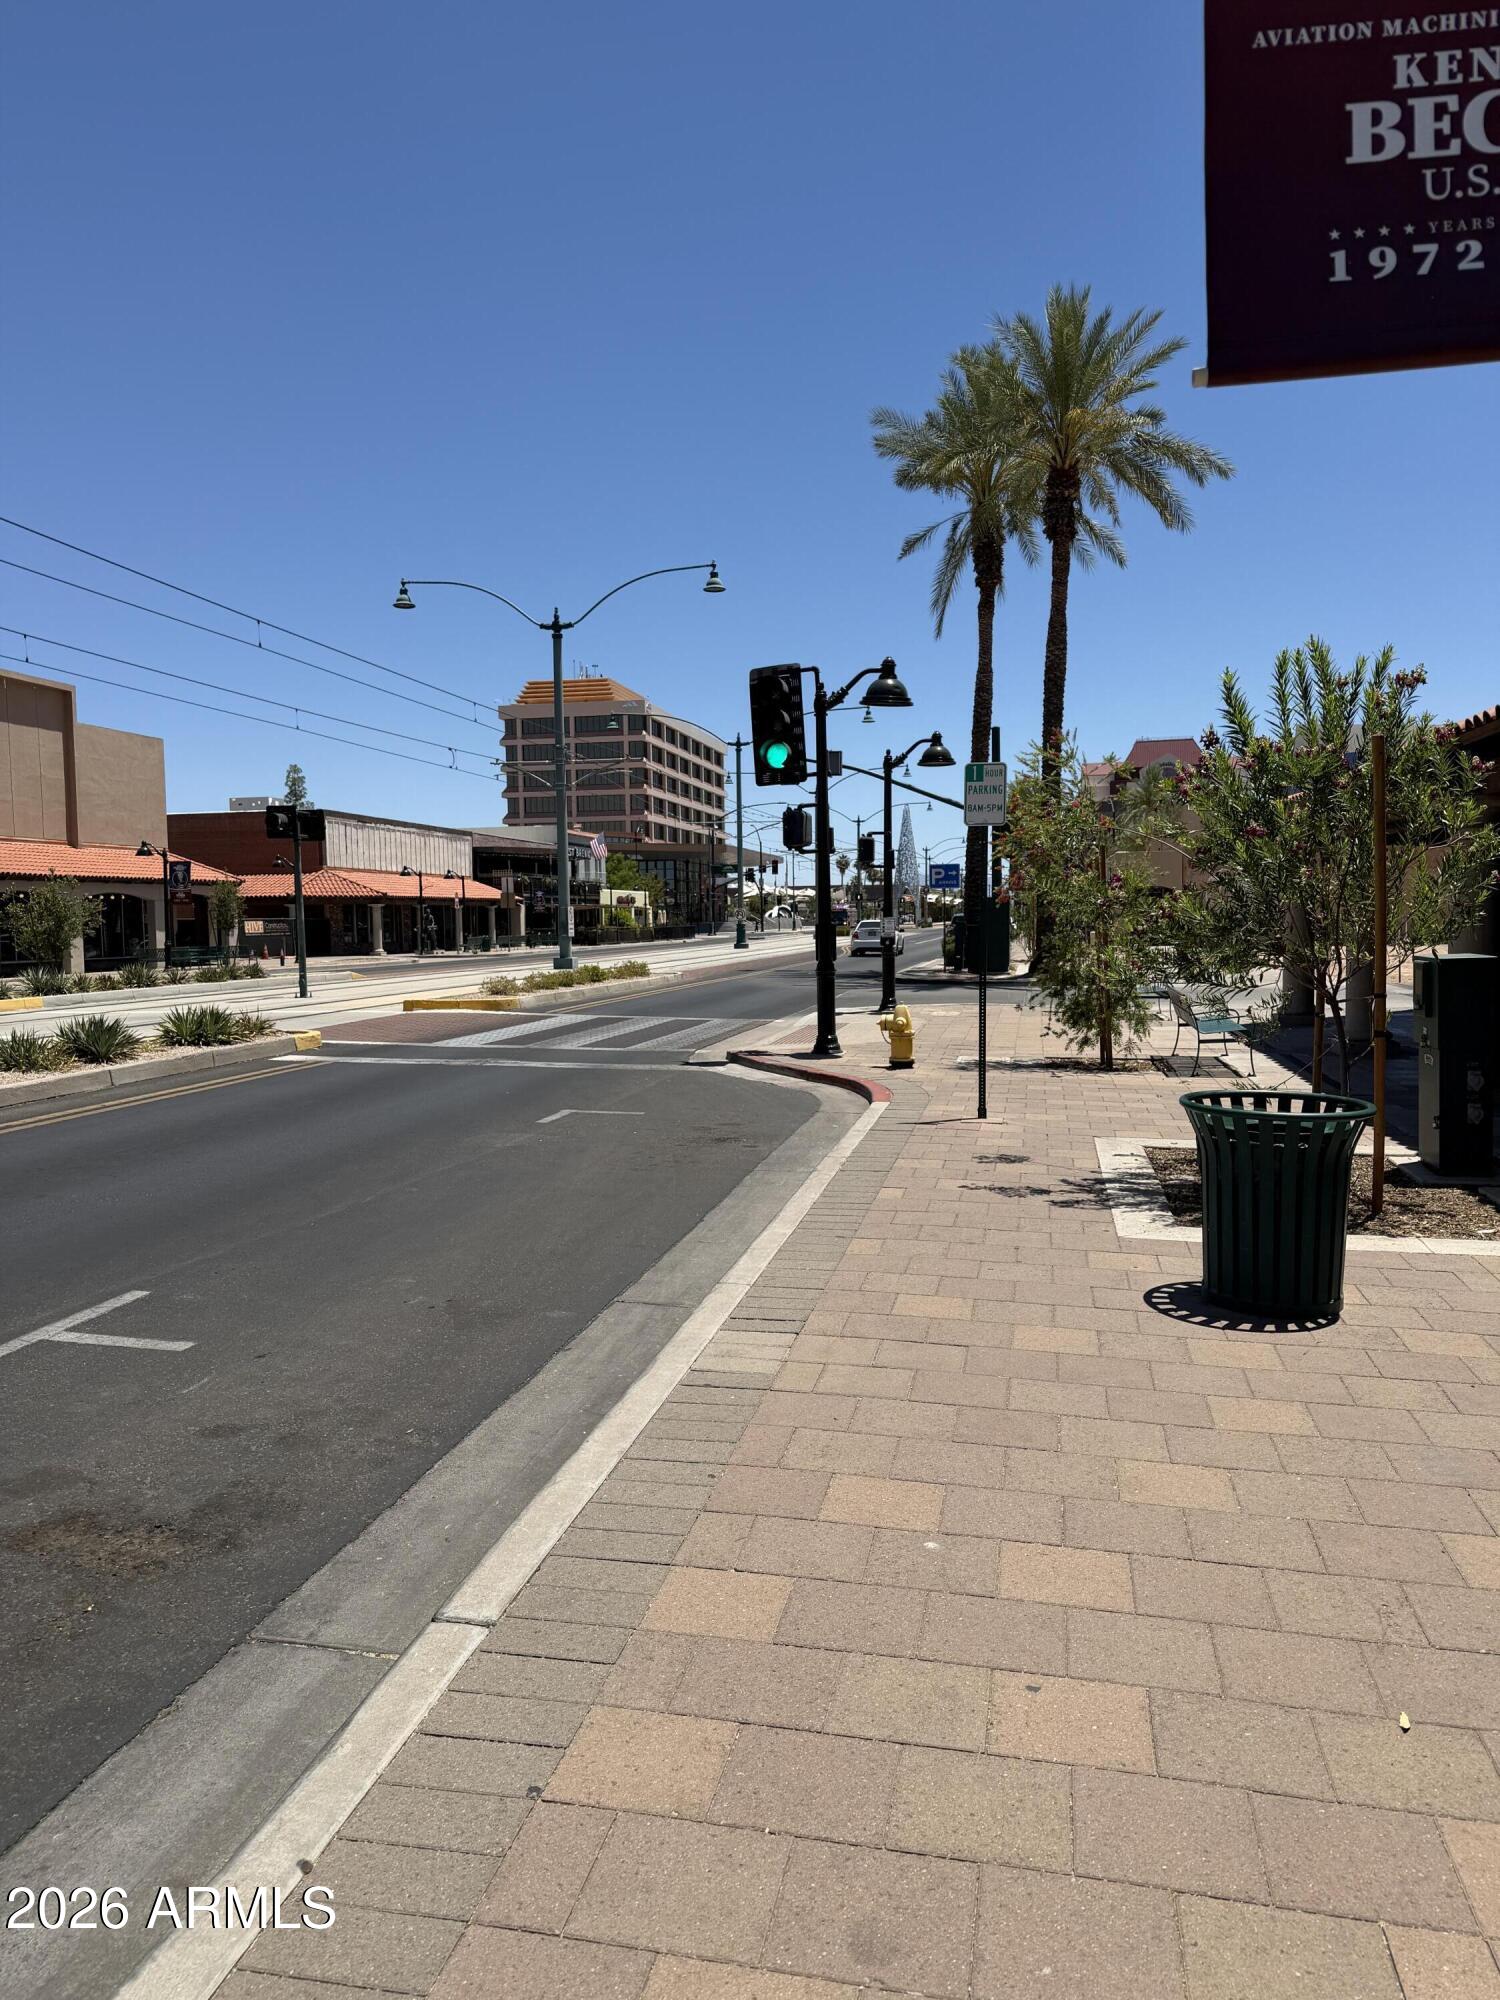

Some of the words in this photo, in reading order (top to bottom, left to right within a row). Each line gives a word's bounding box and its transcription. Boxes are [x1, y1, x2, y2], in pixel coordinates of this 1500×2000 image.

[1252, 21, 1374, 48] AVIATION
[1382, 9, 1500, 37] MACHINI
[1392, 45, 1500, 89] KEN
[1421, 163, 1500, 201] U.S.
[1428, 216, 1495, 233] YEARS
[1328, 239, 1486, 282] 1972
[972, 765, 978, 781] 1
[985, 768, 1003, 777] HOUR
[967, 784, 1004, 795] PARKING
[967, 803, 1003, 813] 8AM-5PM
